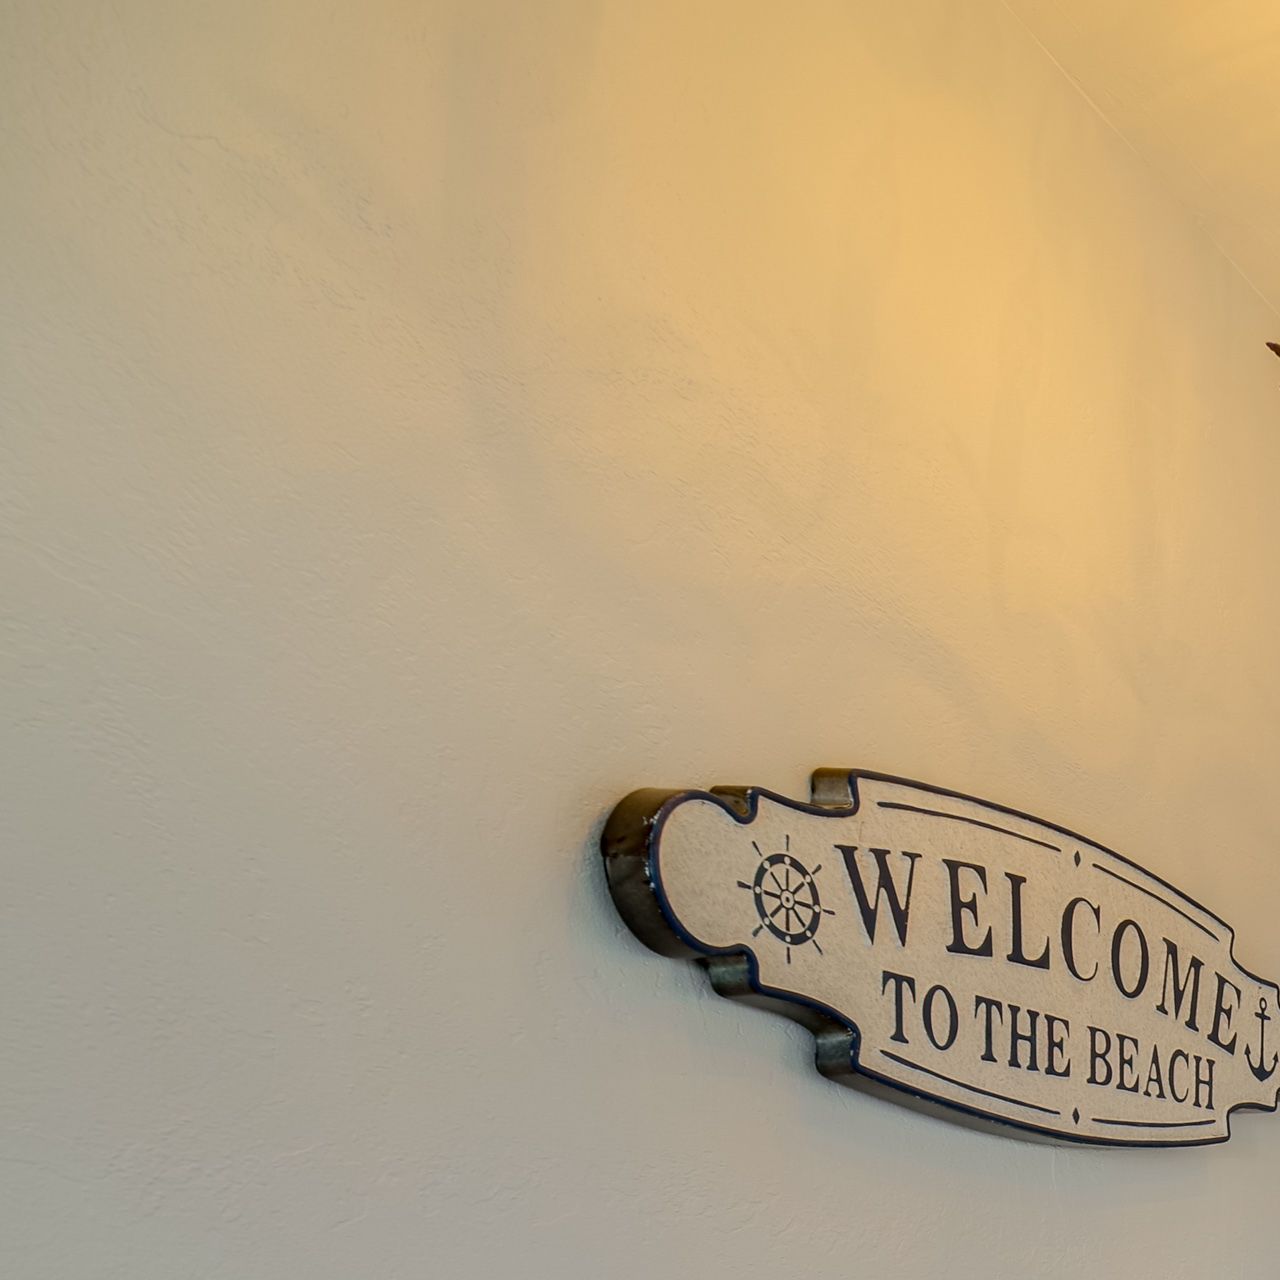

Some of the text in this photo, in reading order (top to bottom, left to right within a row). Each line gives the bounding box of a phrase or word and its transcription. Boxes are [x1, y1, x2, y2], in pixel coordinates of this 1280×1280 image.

[834, 844, 1242, 1056] WELCOME
[881, 970, 1216, 1110] TO THE BEACH
